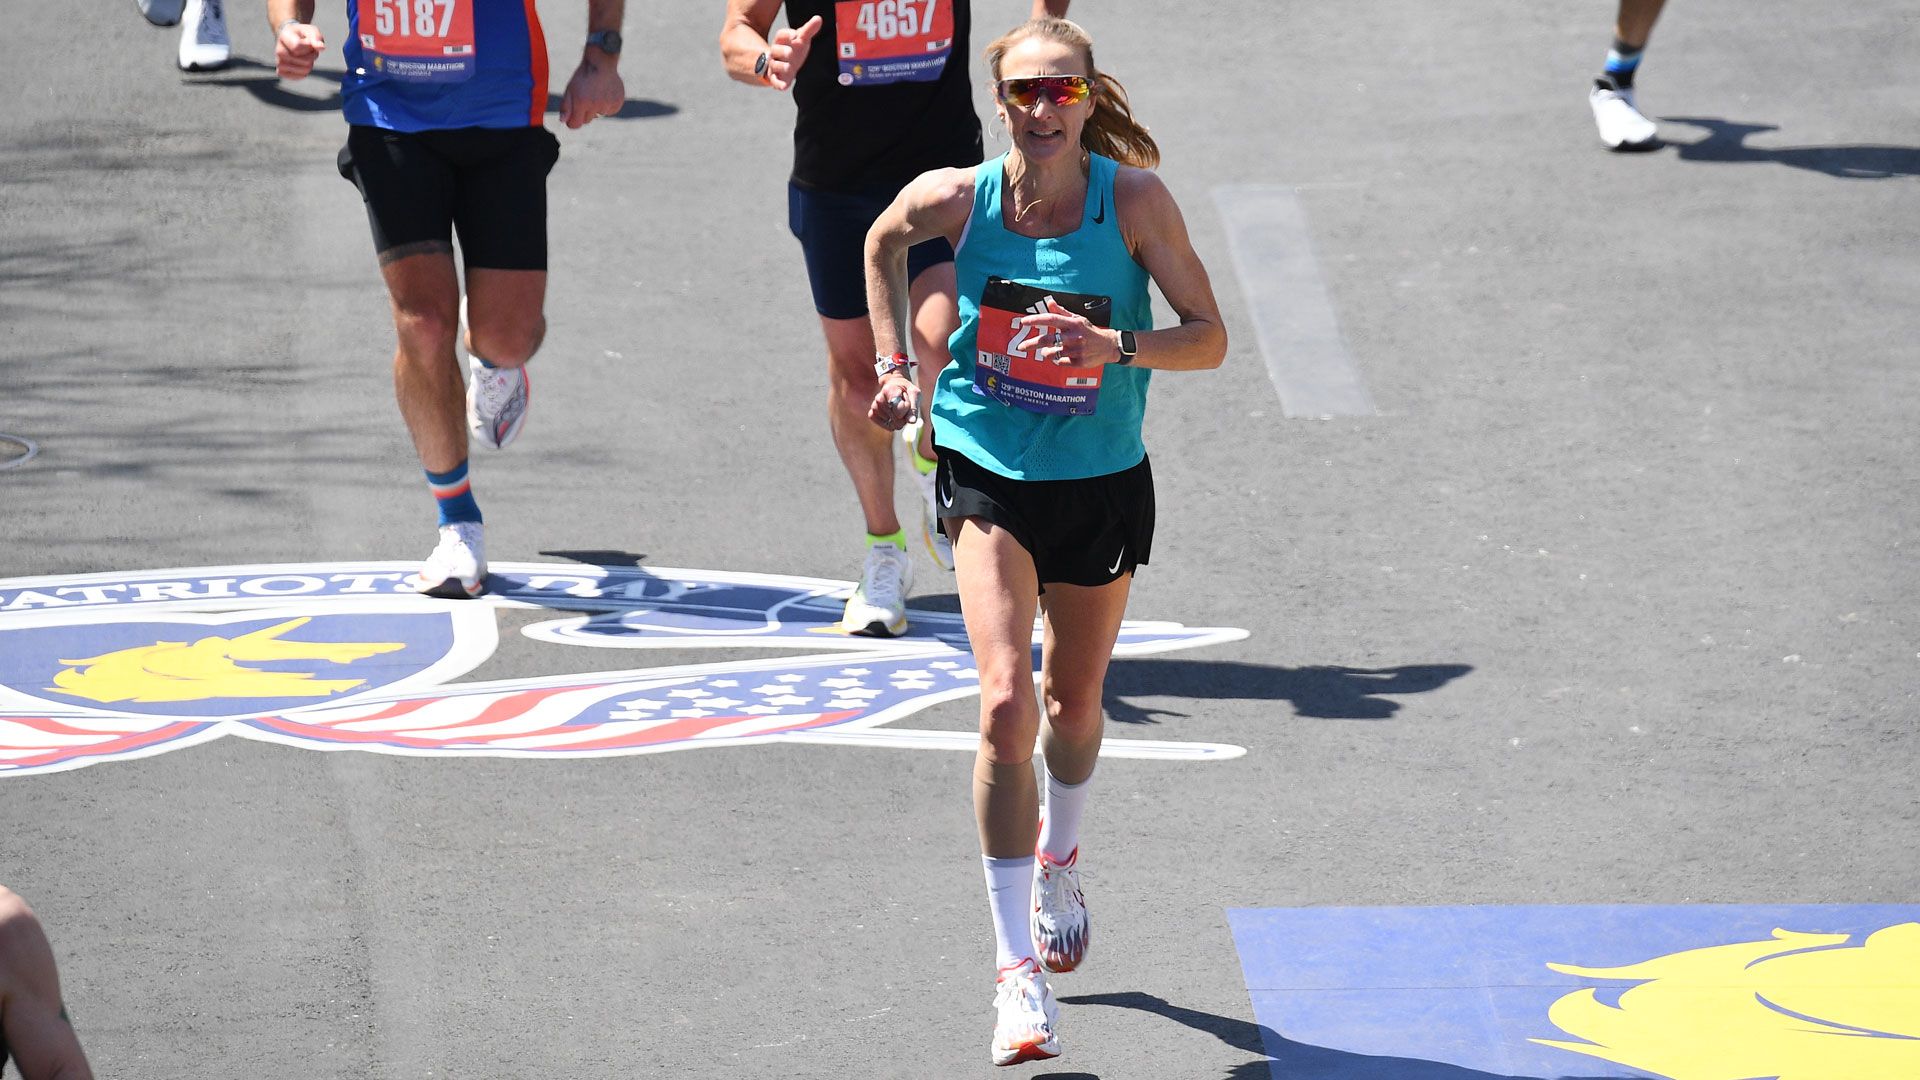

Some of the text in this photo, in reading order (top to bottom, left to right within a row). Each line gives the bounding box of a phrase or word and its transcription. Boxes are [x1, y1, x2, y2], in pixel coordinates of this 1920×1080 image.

[375, 0, 456, 38] 5187
[856, 0, 936, 40] 4657
[1015, 386, 1044, 399] BOSTON
[1045, 393, 1087, 403] MARATHON
[1024, 397, 1049, 406] AMERICA
